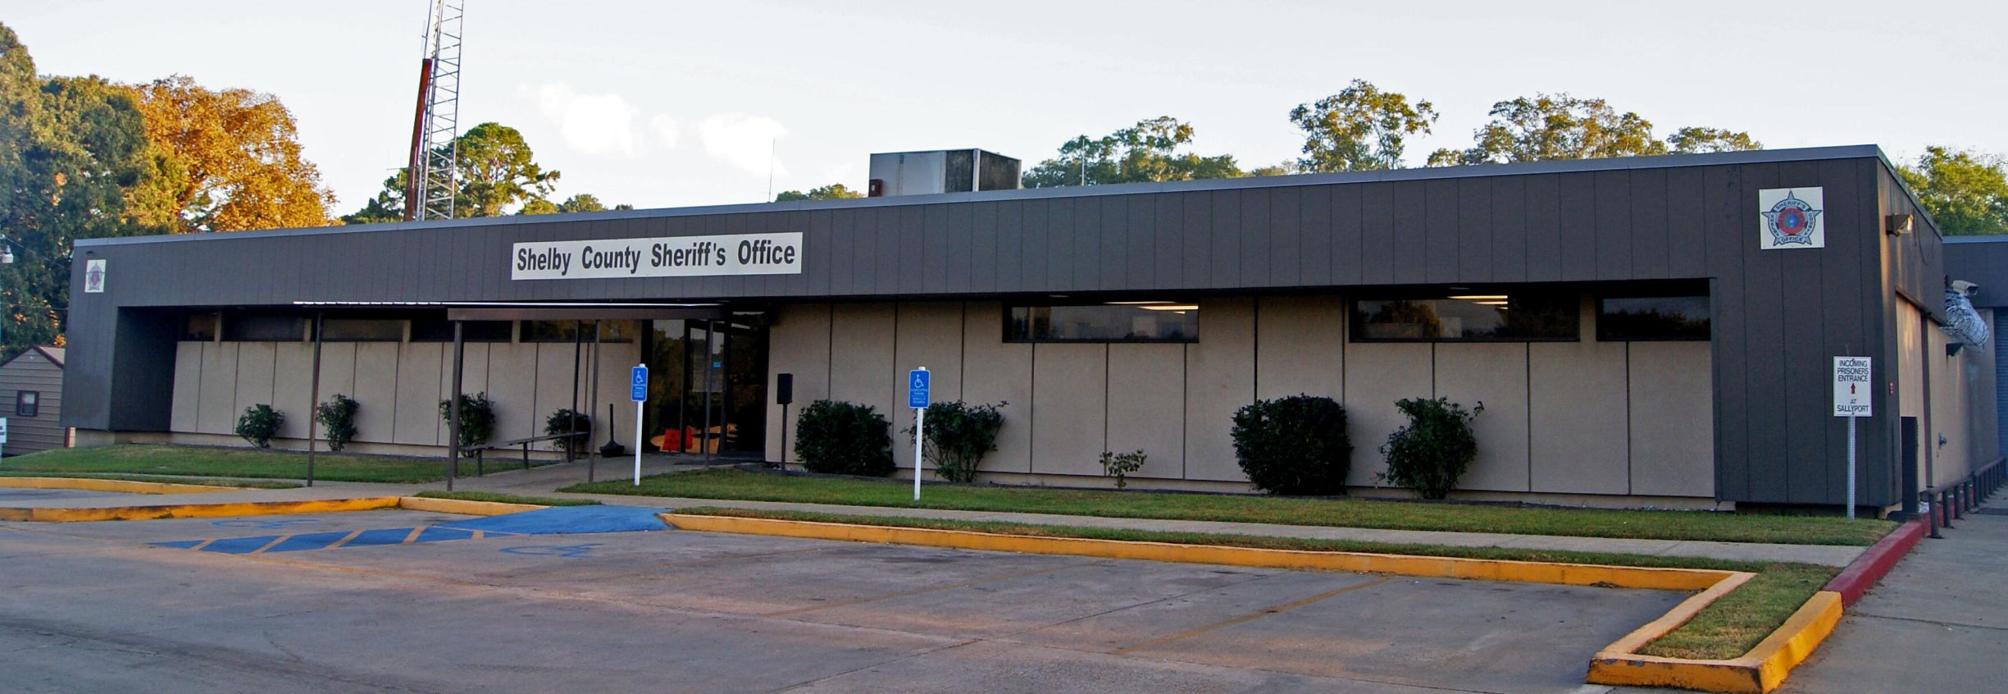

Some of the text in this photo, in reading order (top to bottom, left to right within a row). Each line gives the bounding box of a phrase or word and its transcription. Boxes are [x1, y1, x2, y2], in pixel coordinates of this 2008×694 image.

[517, 240, 796, 275] Shelby County Sheriff's Office
